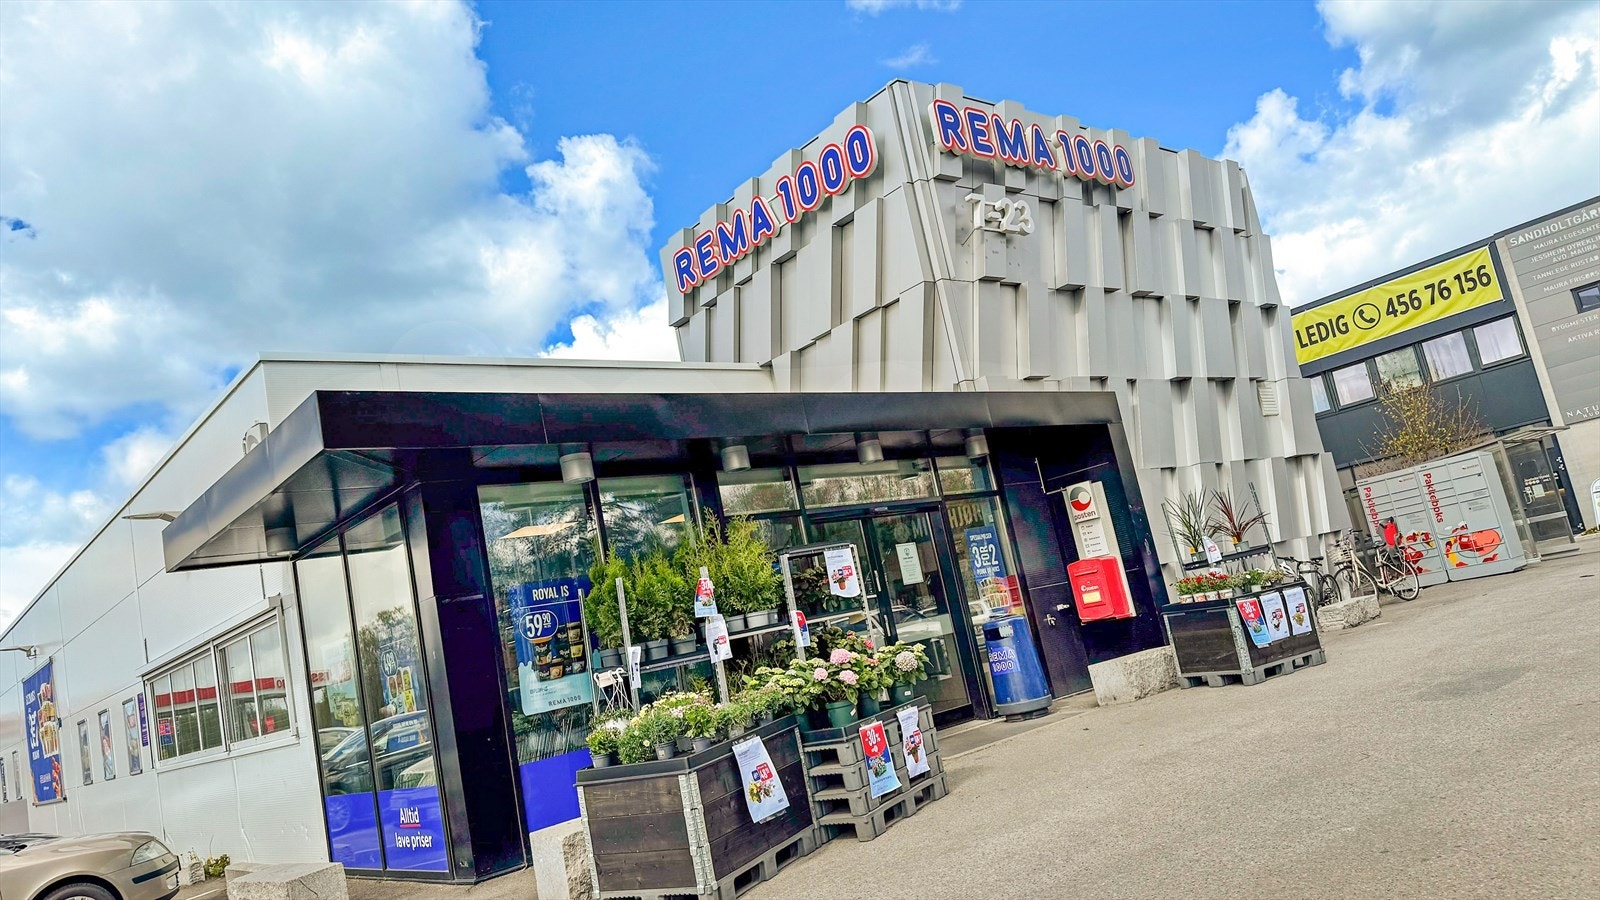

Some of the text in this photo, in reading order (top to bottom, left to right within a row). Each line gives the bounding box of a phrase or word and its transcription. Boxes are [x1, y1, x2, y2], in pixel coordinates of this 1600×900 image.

[932, 99, 1135, 188] REMA 1000
[673, 124, 877, 294] REMA 1000
[965, 193, 1035, 237] T-23
[1533, 238, 1559, 250] MAURA
[1570, 243, 1598, 256] MAURA
[1530, 247, 1566, 264] JESSHEIM
[1532, 263, 1569, 281] TANNLEGE
[1543, 269, 1600, 293] MAURA FRISØRS
[1295, 264, 1492, 349] LEDIG 456 76 156
[1423, 472, 1444, 524] Pakkeboks
[1074, 510, 1097, 522] posten
[971, 543, 999, 569] 3 FOR 2
[532, 585, 570, 601] ROYAL IS
[525, 613, 543, 638] 59
[992, 660, 1014, 673] 1000
[548, 694, 582, 707] REMA 1000
[400, 806, 420, 824] Alltid
[394, 831, 433, 852] lave priser
